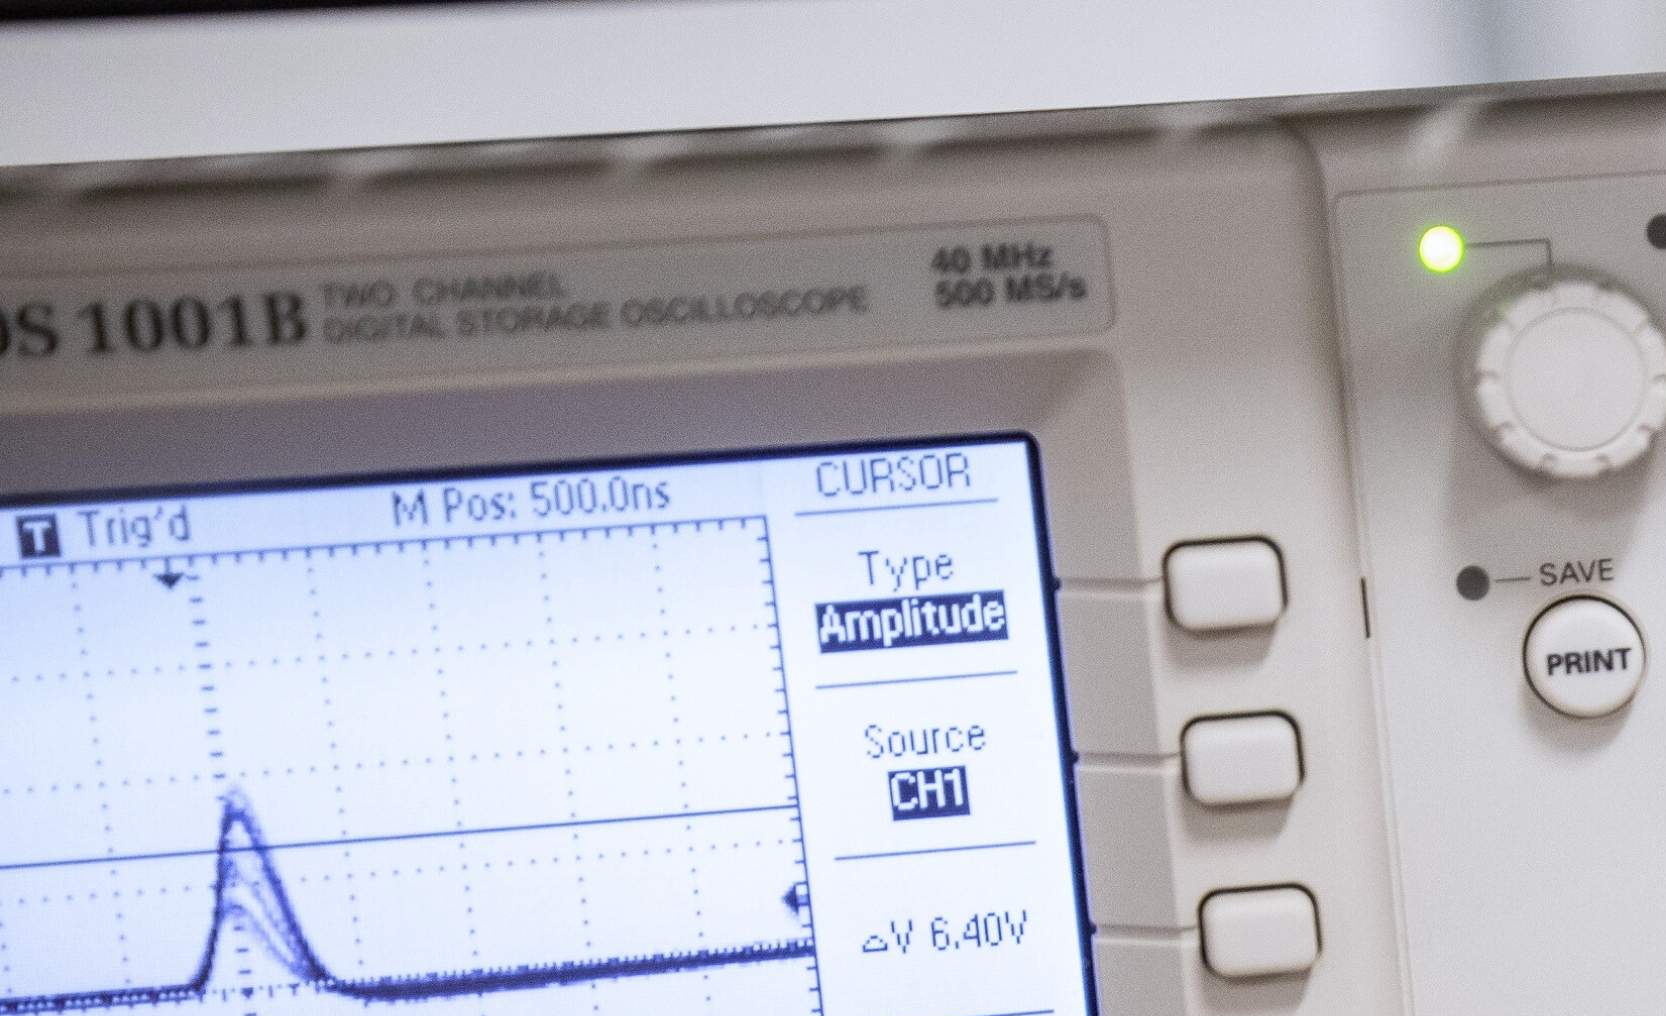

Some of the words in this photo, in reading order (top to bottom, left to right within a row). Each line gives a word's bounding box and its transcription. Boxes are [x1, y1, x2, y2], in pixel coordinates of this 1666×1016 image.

[931, 247, 972, 274] 40
[981, 243, 1054, 271] MHz
[322, 279, 395, 311] TWO
[411, 270, 566, 308] CHANNEL
[933, 279, 994, 311] 500
[1004, 271, 1088, 303] MS/s
[77, 288, 308, 358] 1001B
[321, 311, 447, 345] DIGITAL
[456, 299, 610, 337] STORAGE
[619, 284, 871, 328] OSCILLOSCOPE
[815, 452, 972, 498] CURSOR
[392, 491, 429, 528] M
[442, 486, 517, 524] Pos:
[529, 476, 671, 517] 500.0ns
[78, 506, 191, 549] Trig'd
[858, 549, 955, 592] Type
[1538, 558, 1614, 588] SAVE
[817, 594, 1005, 650] Amplitude
[1546, 646, 1633, 677] PRINT
[864, 718, 987, 760] Source
[890, 766, 968, 814] CH1
[931, 909, 1029, 952] 6.40V
